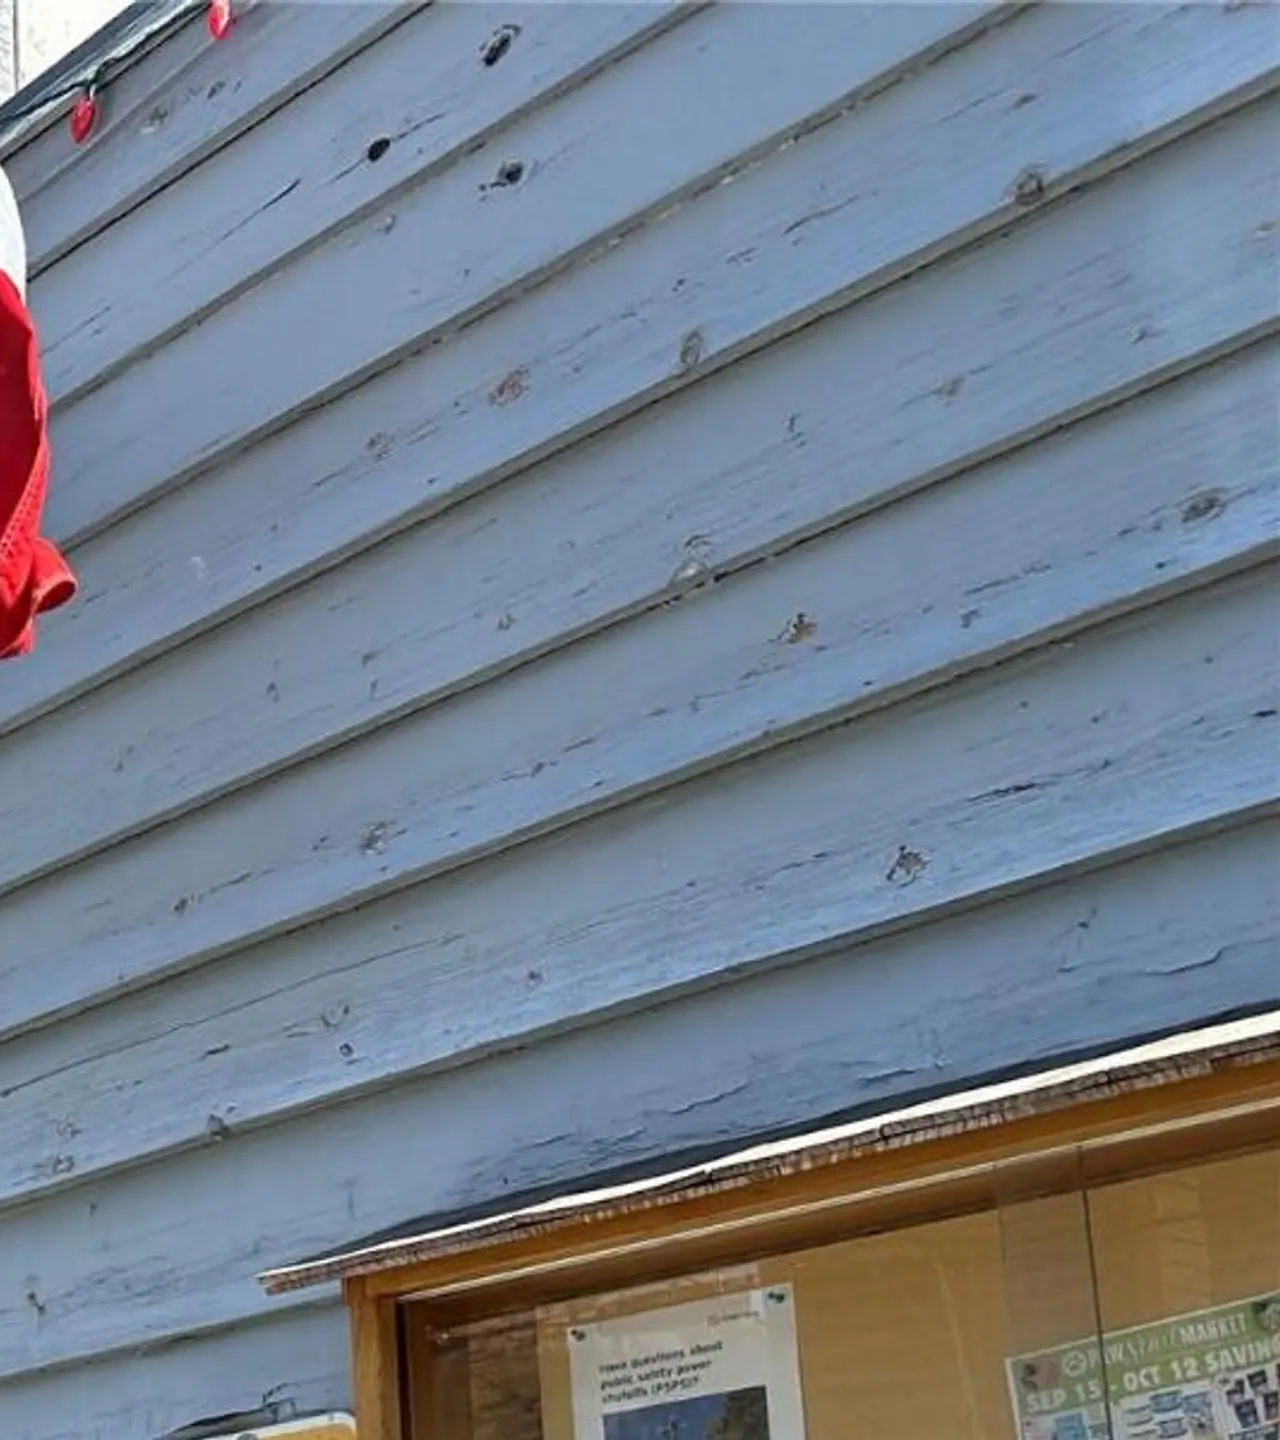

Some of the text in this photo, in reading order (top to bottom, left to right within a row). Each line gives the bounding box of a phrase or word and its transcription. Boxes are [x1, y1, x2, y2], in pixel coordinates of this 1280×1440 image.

[1180, 1312, 1248, 1345] MARKET
[1026, 1388, 1067, 1414] SEP
[1124, 1365, 1162, 1392] OCT
[1171, 1359, 1199, 1382] 12
